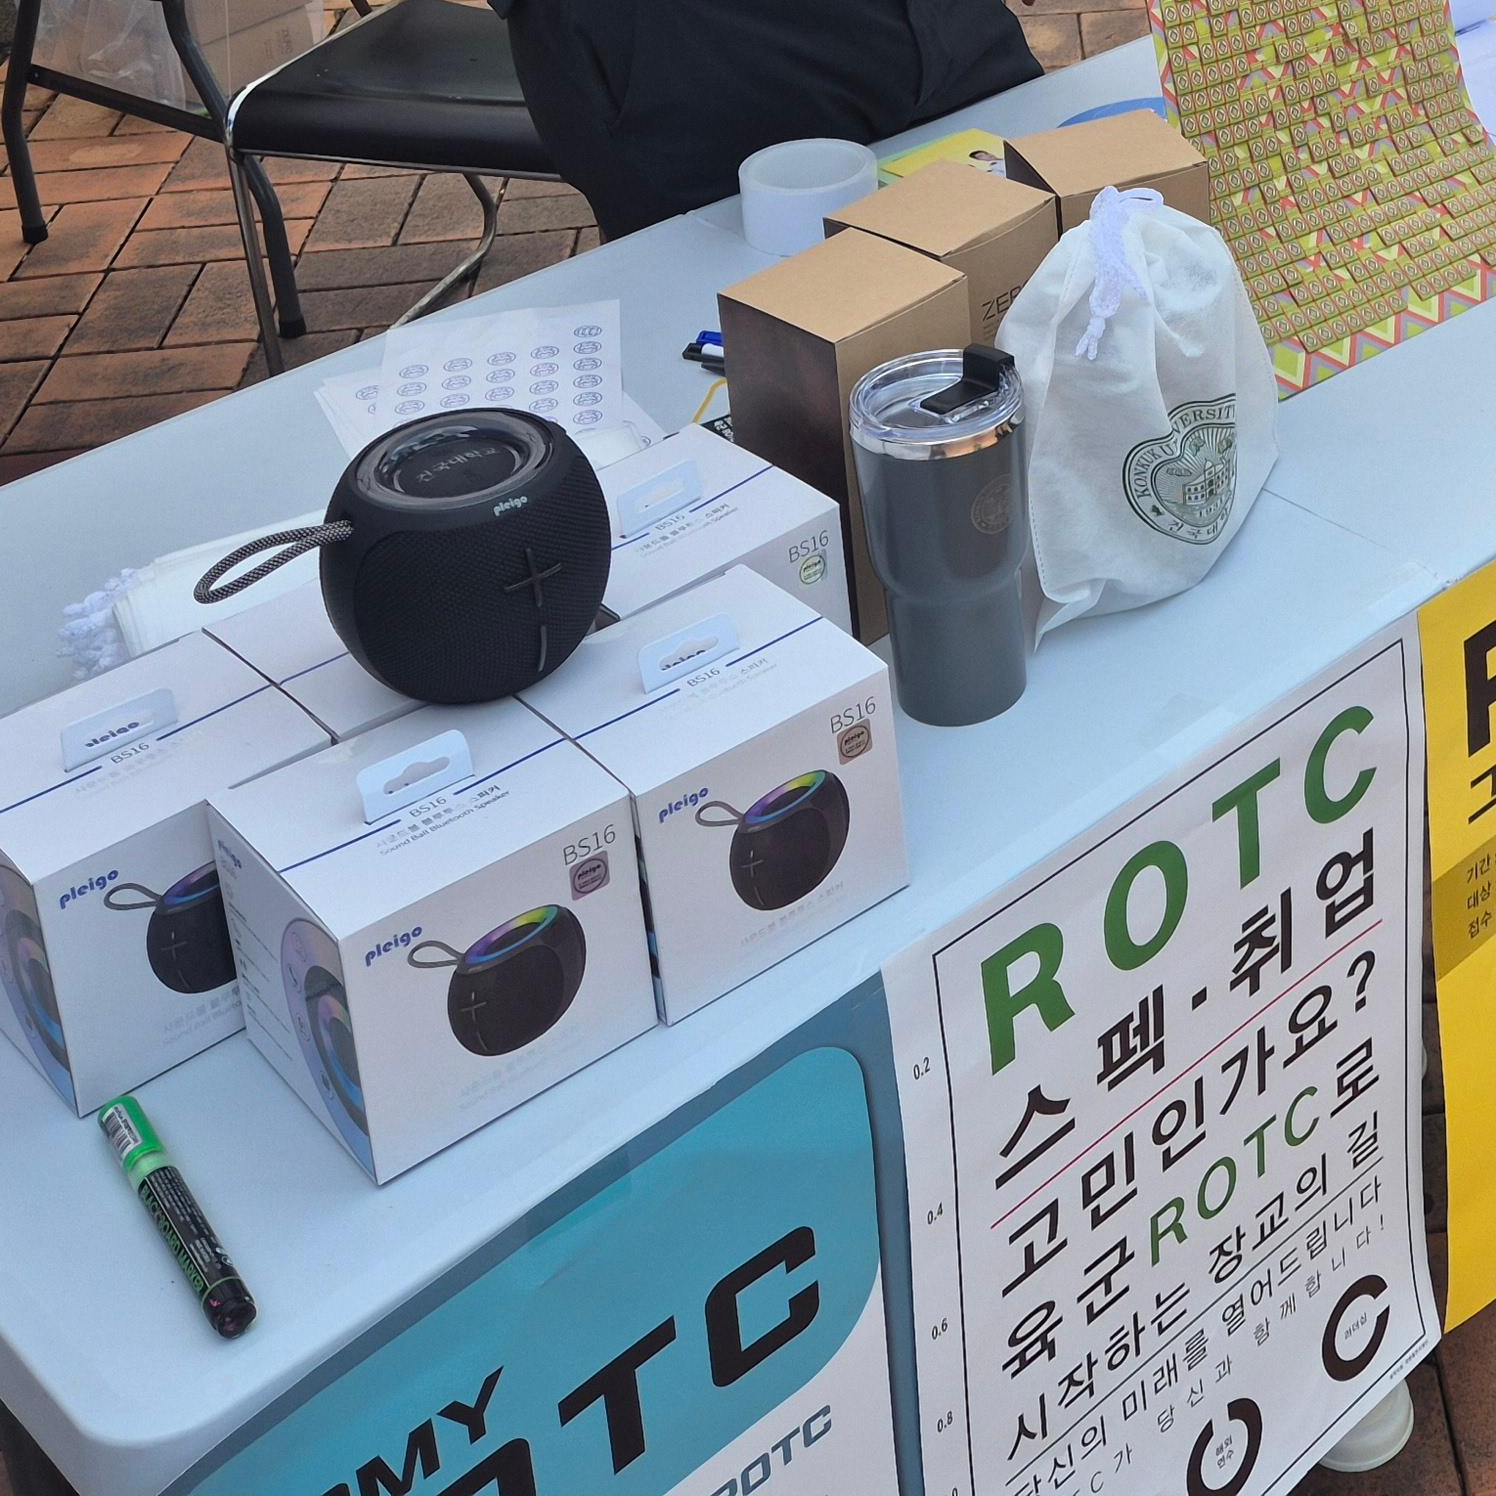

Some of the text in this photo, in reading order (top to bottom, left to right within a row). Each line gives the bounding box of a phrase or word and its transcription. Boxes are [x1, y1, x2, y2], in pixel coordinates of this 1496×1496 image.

[981, 281, 1027, 322] ZER
[1134, 448, 1162, 499] KONKUK
[493, 495, 528, 517] pleigo
[788, 529, 830, 564] BS16
[686, 668, 721, 688] BS16
[830, 695, 877, 735] BS16
[110, 741, 150, 764] BS16
[408, 796, 447, 818] BS16
[658, 787, 709, 824] pleigo
[562, 823, 616, 865] BS16
[1466, 852, 1491, 884] 기간
[59, 869, 119, 910] pleigo
[980, 705, 1378, 1077] ROTC
[1466, 879, 1491, 910] 대상
[1468, 909, 1492, 939] 접수
[364, 925, 424, 968] pleigo
[912, 1056, 931, 1082] 0.2
[1002, 950, 1376, 1299] 고민인가요?
[926, 1202, 944, 1226] 0.4
[1007, 1109, 1379, 1461] 시작하는 장교의 길
[1121, 1327, 1209, 1421] 미래를
[1221, 1175, 1382, 1337] 열어드립니다
[931, 1318, 949, 1340] 0.6
[1344, 1311, 1368, 1340] 리더십
[936, 1411, 953, 1433] 0.8
